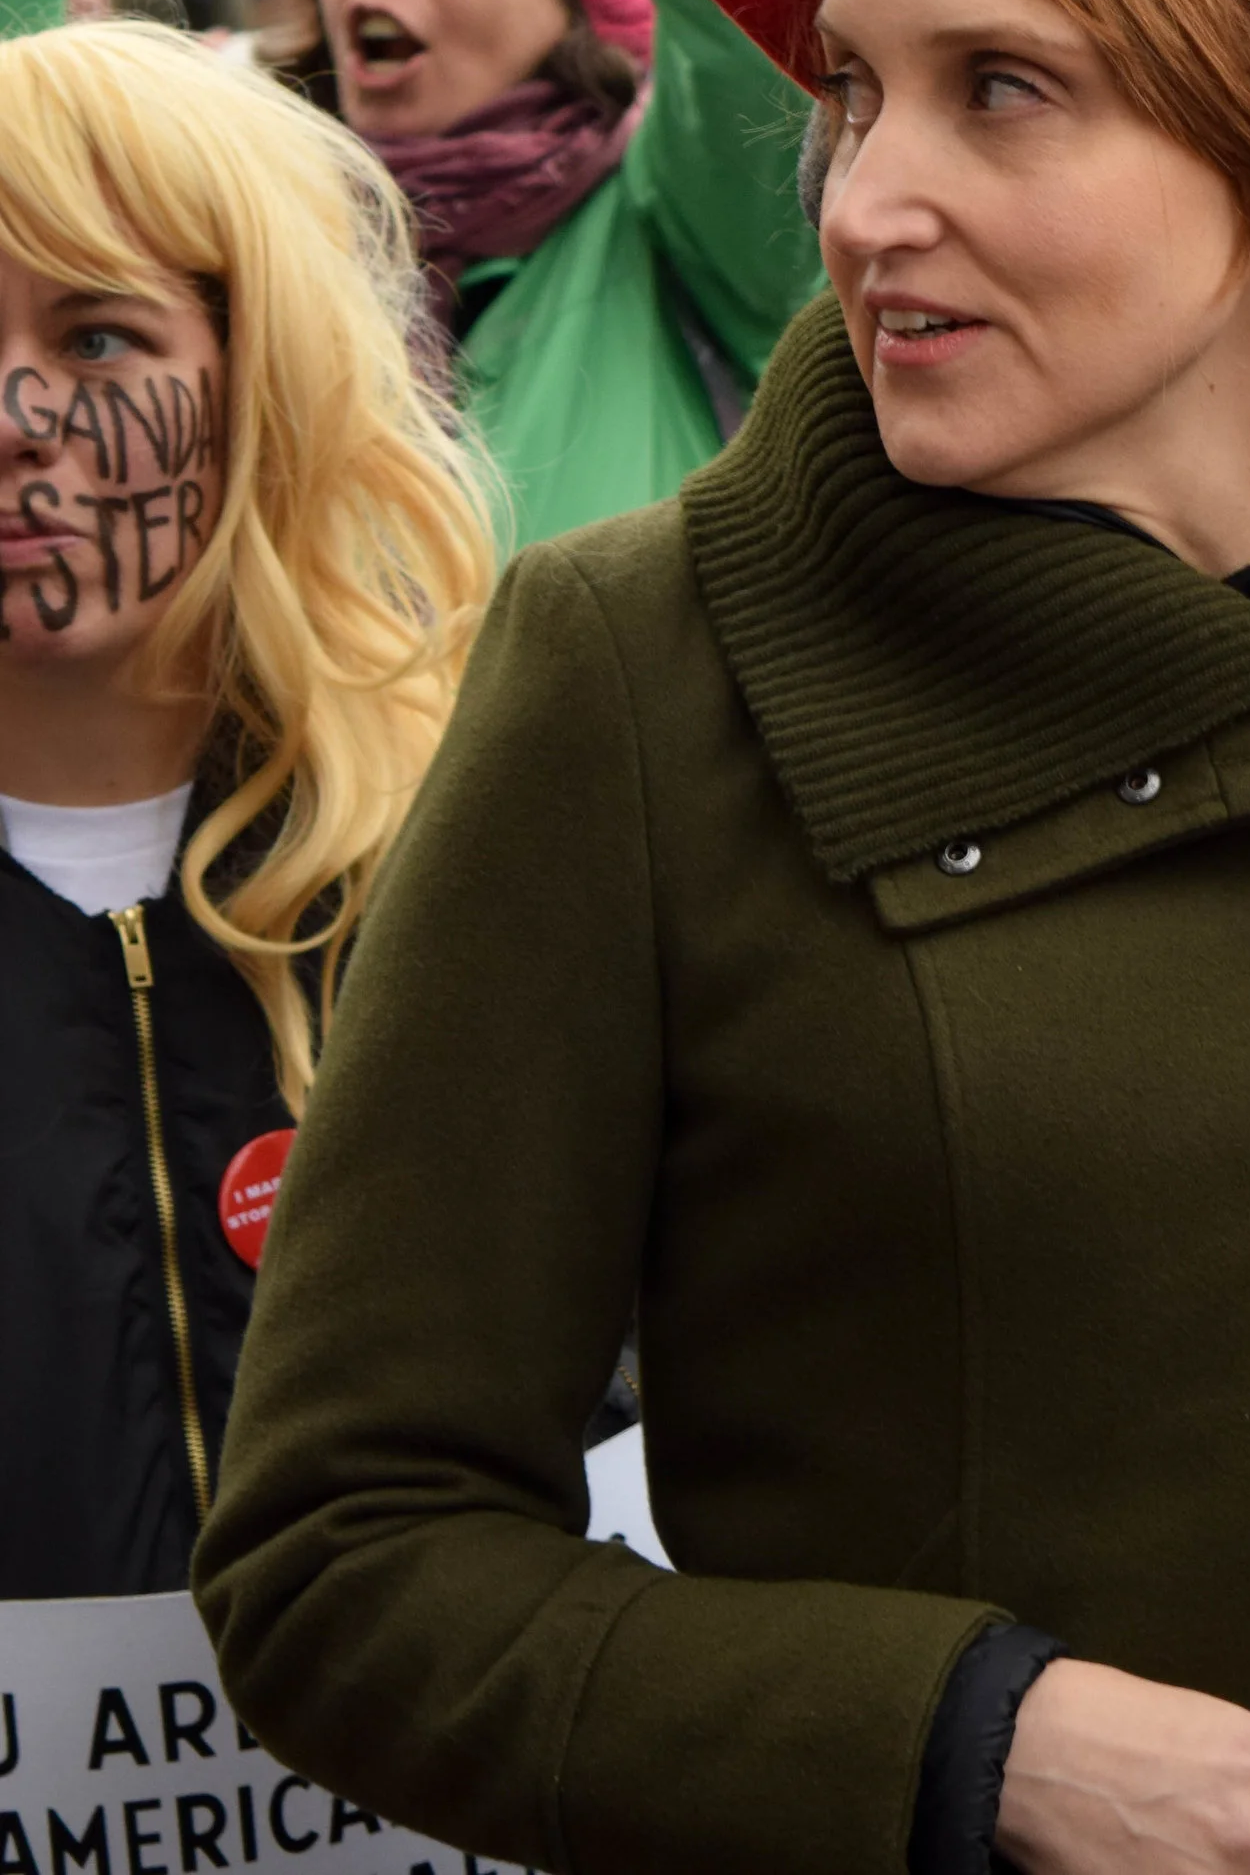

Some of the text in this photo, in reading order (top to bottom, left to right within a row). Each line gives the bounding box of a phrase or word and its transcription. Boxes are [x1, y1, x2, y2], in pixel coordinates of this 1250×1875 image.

[2, 366, 217, 484] GANDA
[0, 479, 204, 640] STER
[226, 1204, 272, 1230] STOP
[233, 1189, 244, 1205] I
[0, 1775, 400, 1875] AMERICA
